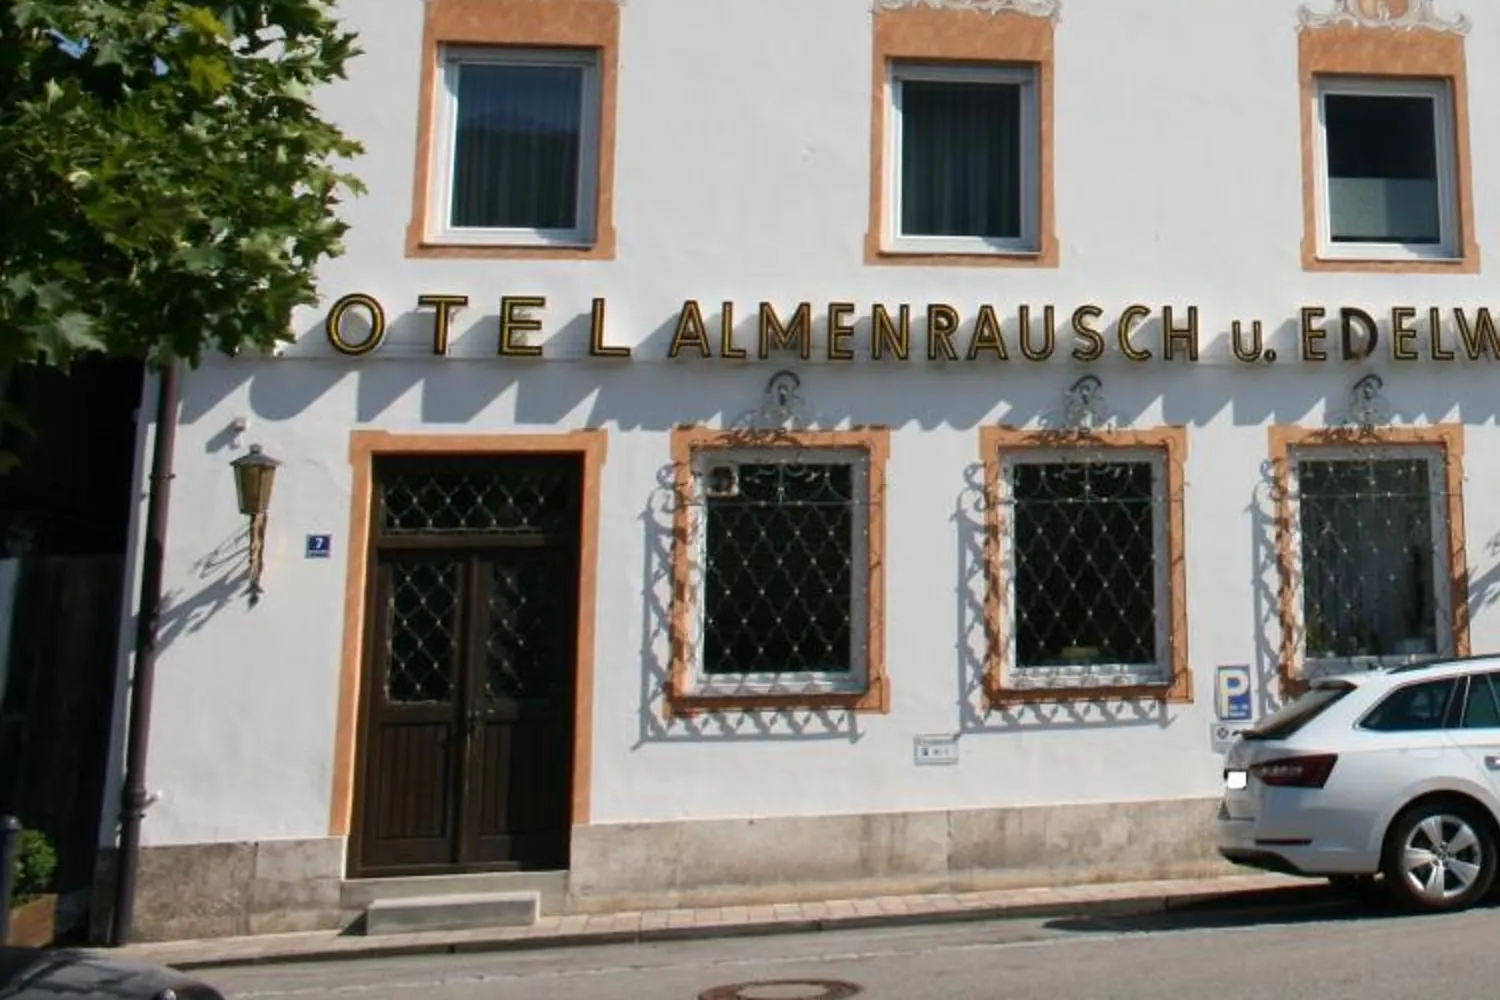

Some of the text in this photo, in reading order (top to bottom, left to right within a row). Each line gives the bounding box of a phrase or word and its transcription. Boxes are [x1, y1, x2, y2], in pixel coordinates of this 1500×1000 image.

[232, 292, 632, 358] OTEL
[668, 300, 1199, 361] ALMENRAUSCH
[1231, 320, 1277, 362] u.
[1219, 669, 1249, 719] P
